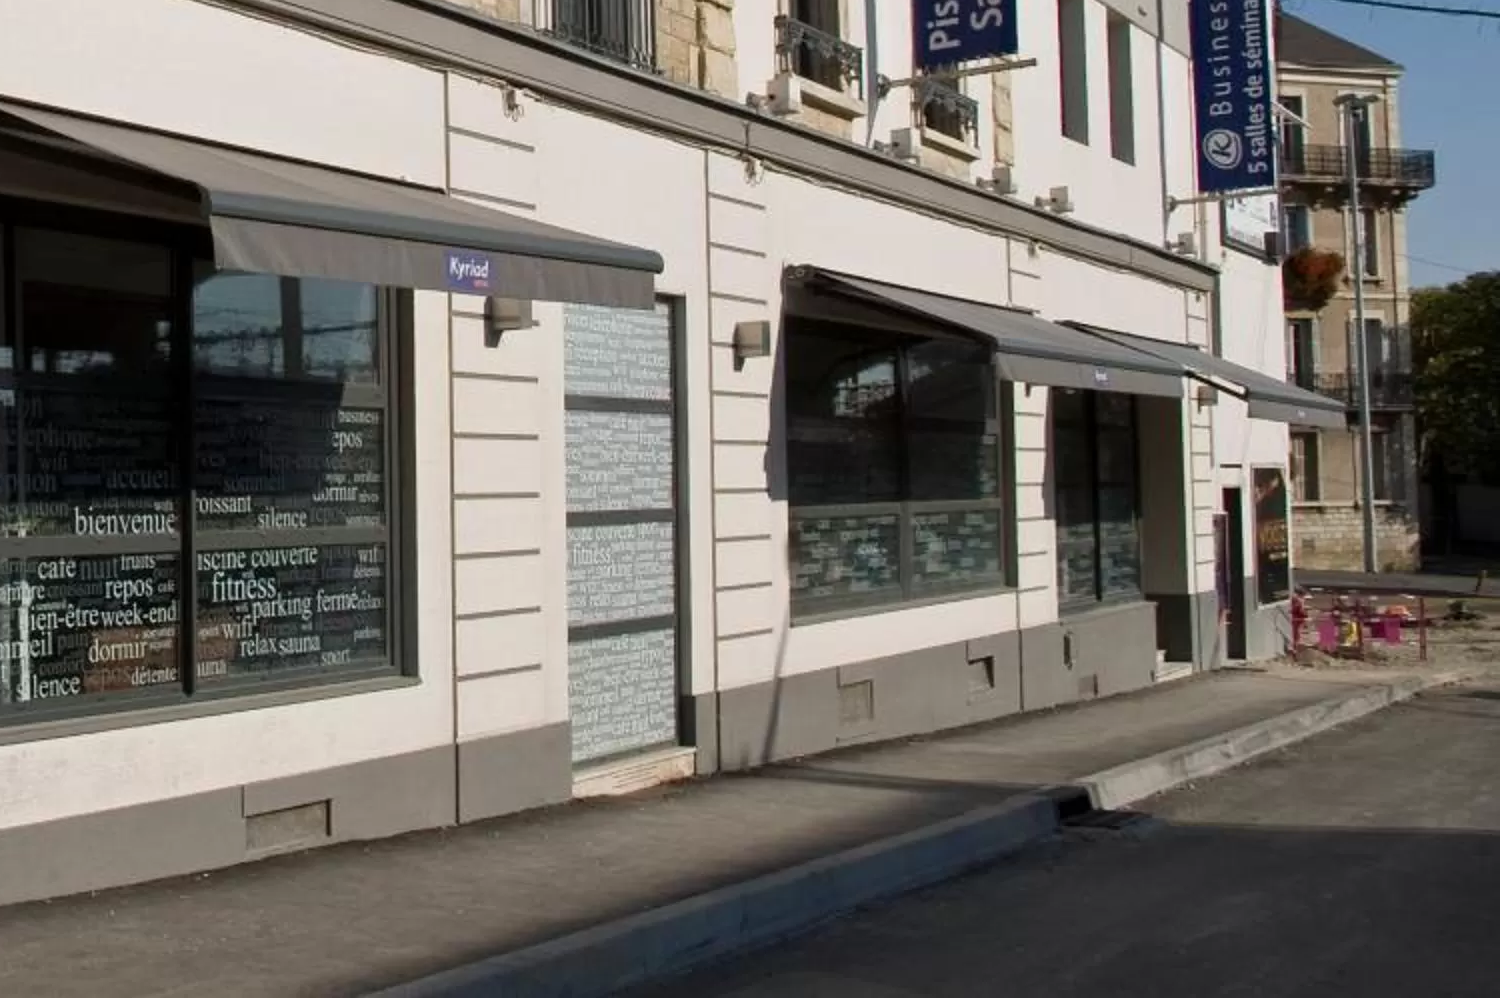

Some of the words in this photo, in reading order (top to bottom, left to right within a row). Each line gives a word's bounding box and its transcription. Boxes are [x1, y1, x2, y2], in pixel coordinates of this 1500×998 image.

[1240, 73, 1264, 99] de
[1243, 103, 1268, 157] salles
[1247, 160, 1269, 174] 5
[449, 256, 490, 281] Kyriad
[331, 430, 364, 454] epos
[73, 505, 177, 535] bienvenue
[257, 506, 308, 530] silence
[250, 547, 319, 569] couverte
[105, 577, 155, 605] repos
[212, 570, 278, 603] fitness
[29, 602, 100, 631] ien-être
[100, 601, 178, 627] week-end
[251, 590, 314, 626] parking
[316, 585, 359, 613] fermé
[87, 633, 149, 664] dormir
[240, 633, 278, 658] relax
[278, 633, 322, 656] sauna
[16, 674, 82, 701] slence
[131, 665, 179, 688] détente
